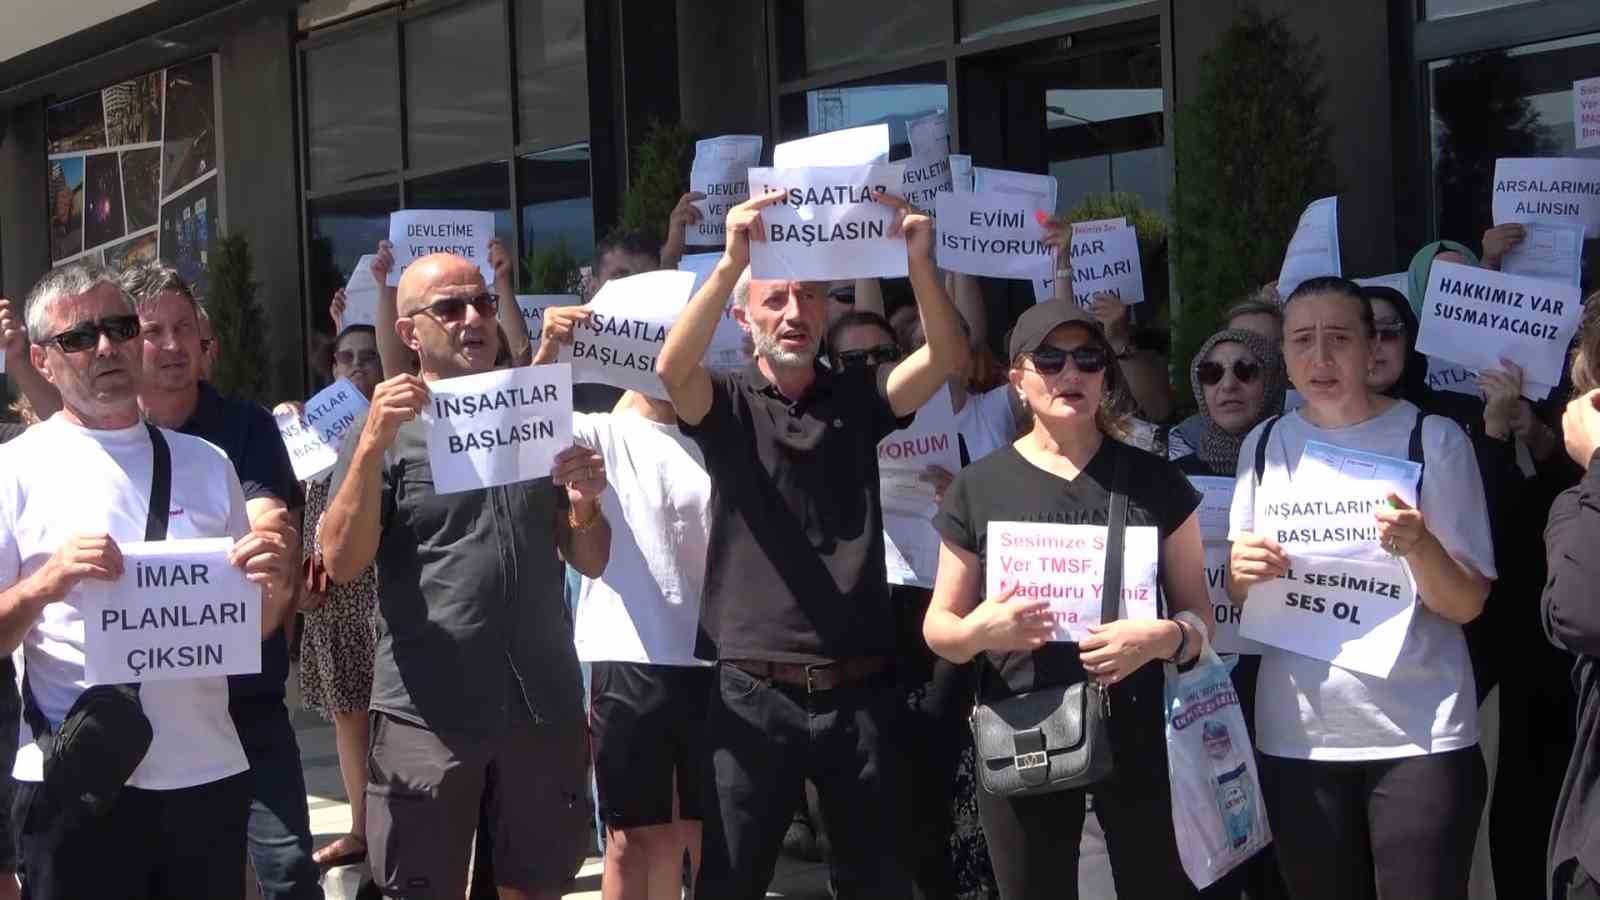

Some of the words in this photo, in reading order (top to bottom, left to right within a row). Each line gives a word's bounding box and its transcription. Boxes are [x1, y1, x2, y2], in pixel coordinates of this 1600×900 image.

[970, 209, 1025, 229] EVİMİ
[1514, 202, 1580, 216] ALINSIN
[407, 221, 473, 237] DEVLETİME
[771, 219, 884, 247] BAŞLASIN
[409, 245, 427, 257] VE
[942, 233, 1052, 256] İSTİYORUM
[1439, 277, 1525, 308] HAKKIMIZ
[1530, 295, 1564, 316] VAR
[572, 340, 657, 373] BAŞLASI
[435, 384, 558, 418] İNŞAATLAR
[448, 420, 554, 454] BAŞLASIN
[1001, 532, 1085, 549] Sesimize
[136, 562, 209, 588] İMAR
[1000, 556, 1031, 573] Ver
[1303, 572, 1401, 600] SESİMİZE
[102, 602, 246, 632] PLANLARI
[1285, 592, 1326, 613] SES
[1332, 602, 1361, 625] OL
[127, 644, 223, 677] ÇIKSIN
